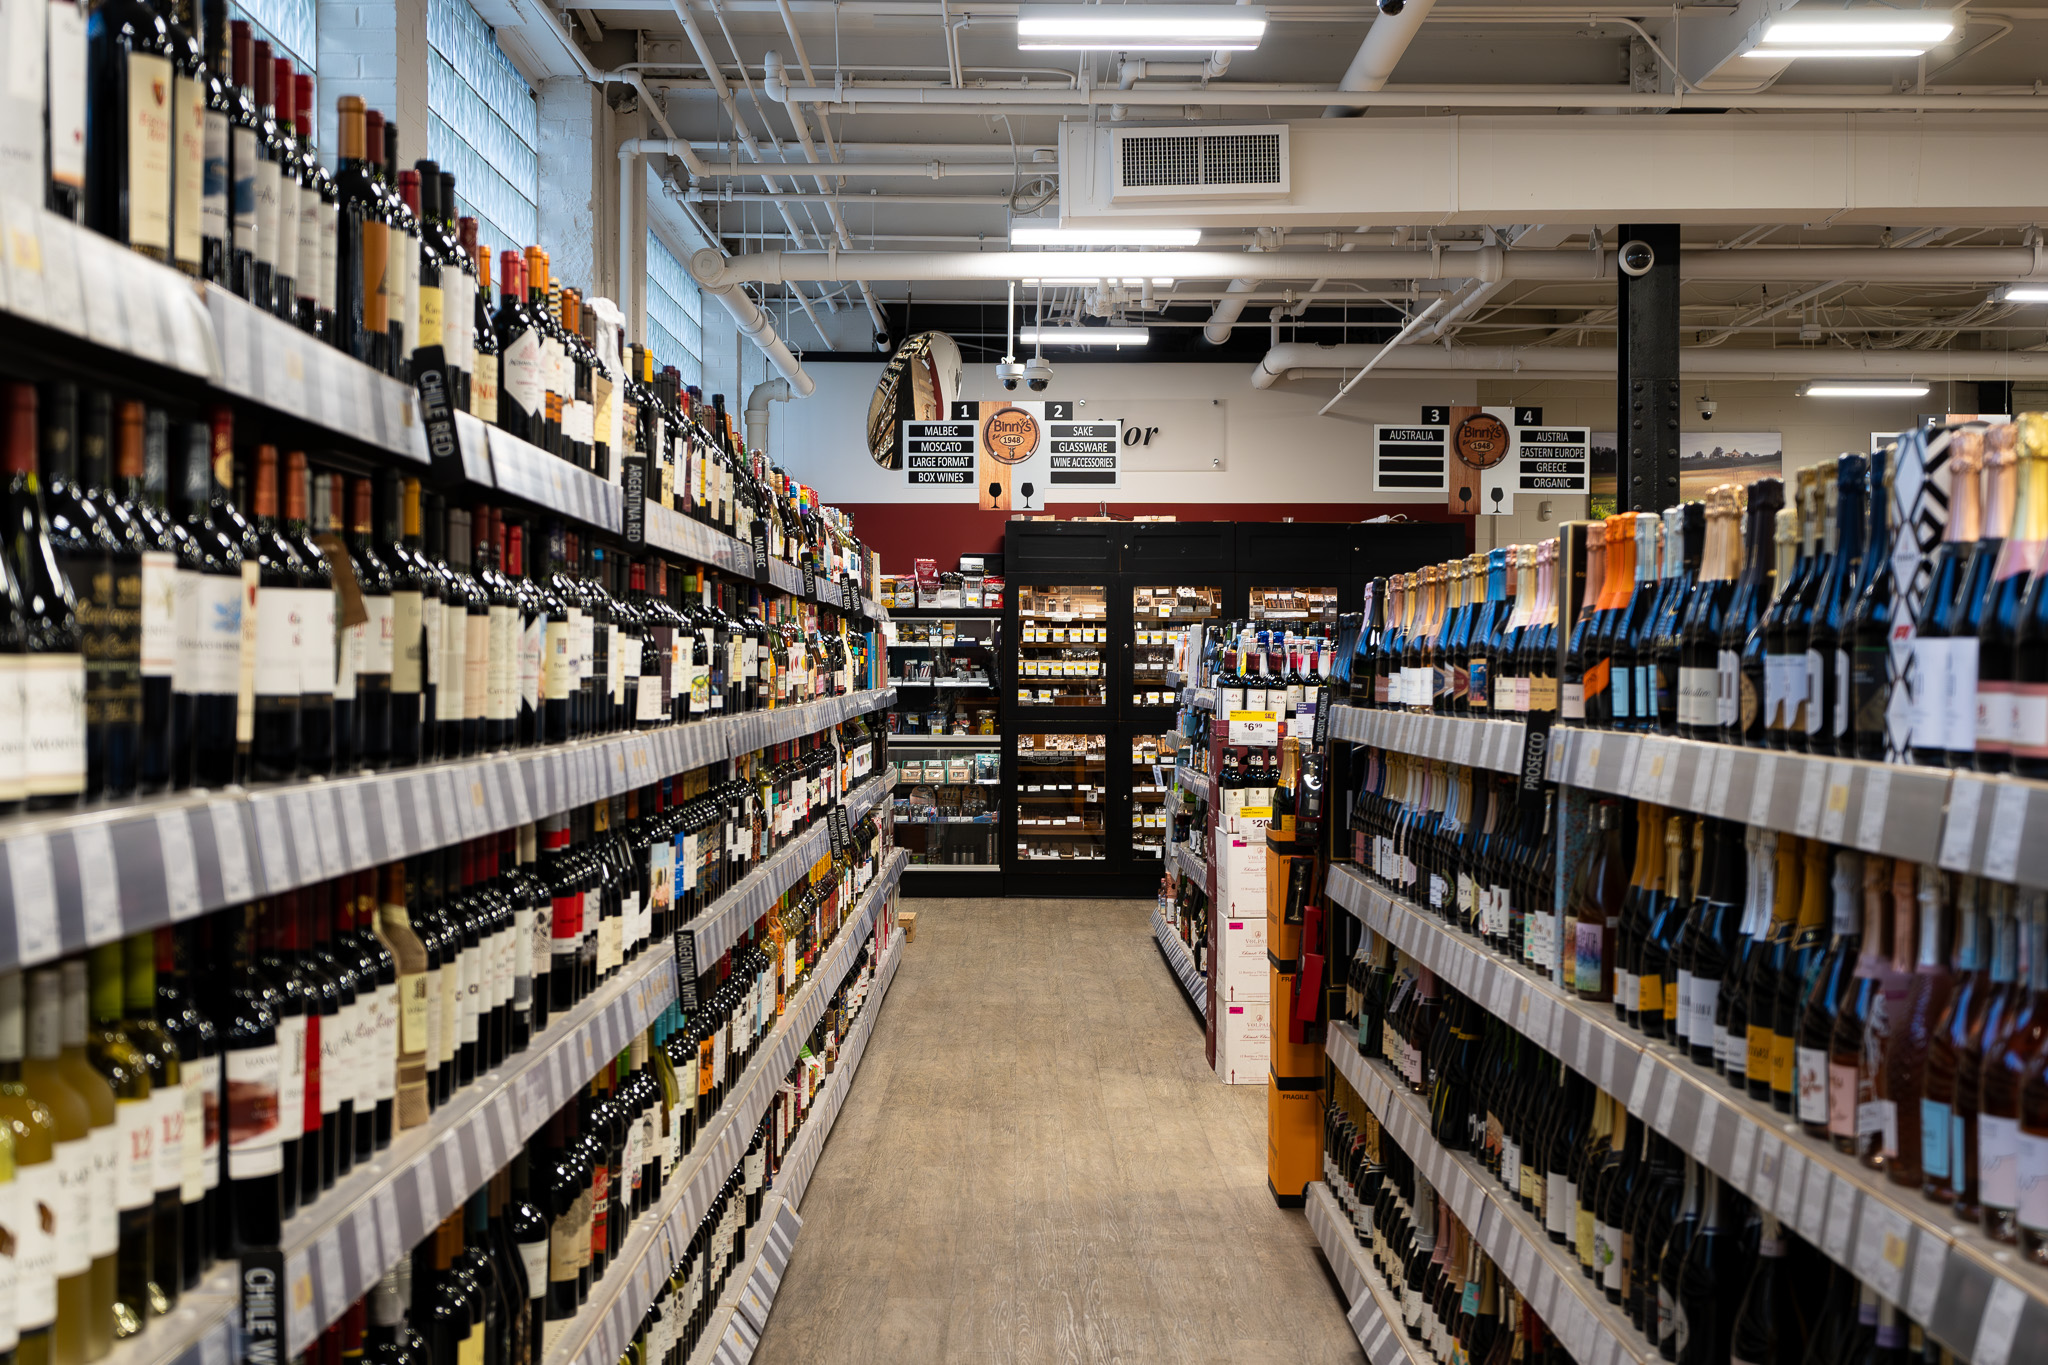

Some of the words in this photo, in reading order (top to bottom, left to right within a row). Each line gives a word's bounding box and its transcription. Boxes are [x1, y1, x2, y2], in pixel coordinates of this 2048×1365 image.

[420, 369, 448, 418] CHILE
[960, 404, 970, 418] 1
[1054, 404, 1063, 418] 2
[1431, 410, 1440, 422] 3
[1523, 410, 1532, 422] 4
[924, 425, 958, 436] MALBEC
[1072, 426, 1094, 437] SAKE
[1389, 430, 1434, 440] AUSTRALIA
[1536, 432, 1569, 442] AUSTRIA
[429, 420, 454, 457] RED
[1003, 436, 1021, 444] 1948
[920, 442, 962, 452] MOSCATO
[1058, 442, 1108, 453] GLASSWARE
[1473, 442, 1491, 450] 1948
[1520, 448, 1553, 458] EASTERN
[1554, 448, 1584, 458] EUROPE
[912, 456, 936, 467] LARGE
[938, 456, 970, 467] FORMAT
[1053, 458, 1071, 468] WINE
[1072, 458, 1114, 468] ACCESSORIES
[1536, 462, 1567, 473] GREECE
[918, 472, 939, 482] BOX
[939, 472, 964, 482] WINES
[1534, 478, 1572, 489] ORGANIC
[627, 463, 642, 521] ARGENTINA
[627, 522, 642, 542] RED
[754, 536, 766, 568] MALBEC
[804, 561, 814, 593] MOSCATO
[842, 577, 850, 595] SWEET
[851, 586, 860, 610] SANGRIA
[1319, 692, 1328, 718] SPARKLING
[1316, 717, 1326, 742] DOMESTIC
[1524, 732, 1545, 790] PROSECCO
[838, 808, 846, 825] FRUIT
[829, 814, 839, 840] MIDWEST
[1252, 820, 1272, 828] $20
[841, 825, 850, 846] WINES
[833, 840, 841, 858] WINES
[678, 934, 695, 983] ARGENTINA
[682, 983, 698, 1012] WHITE
[244, 1267, 276, 1336] CHILE
